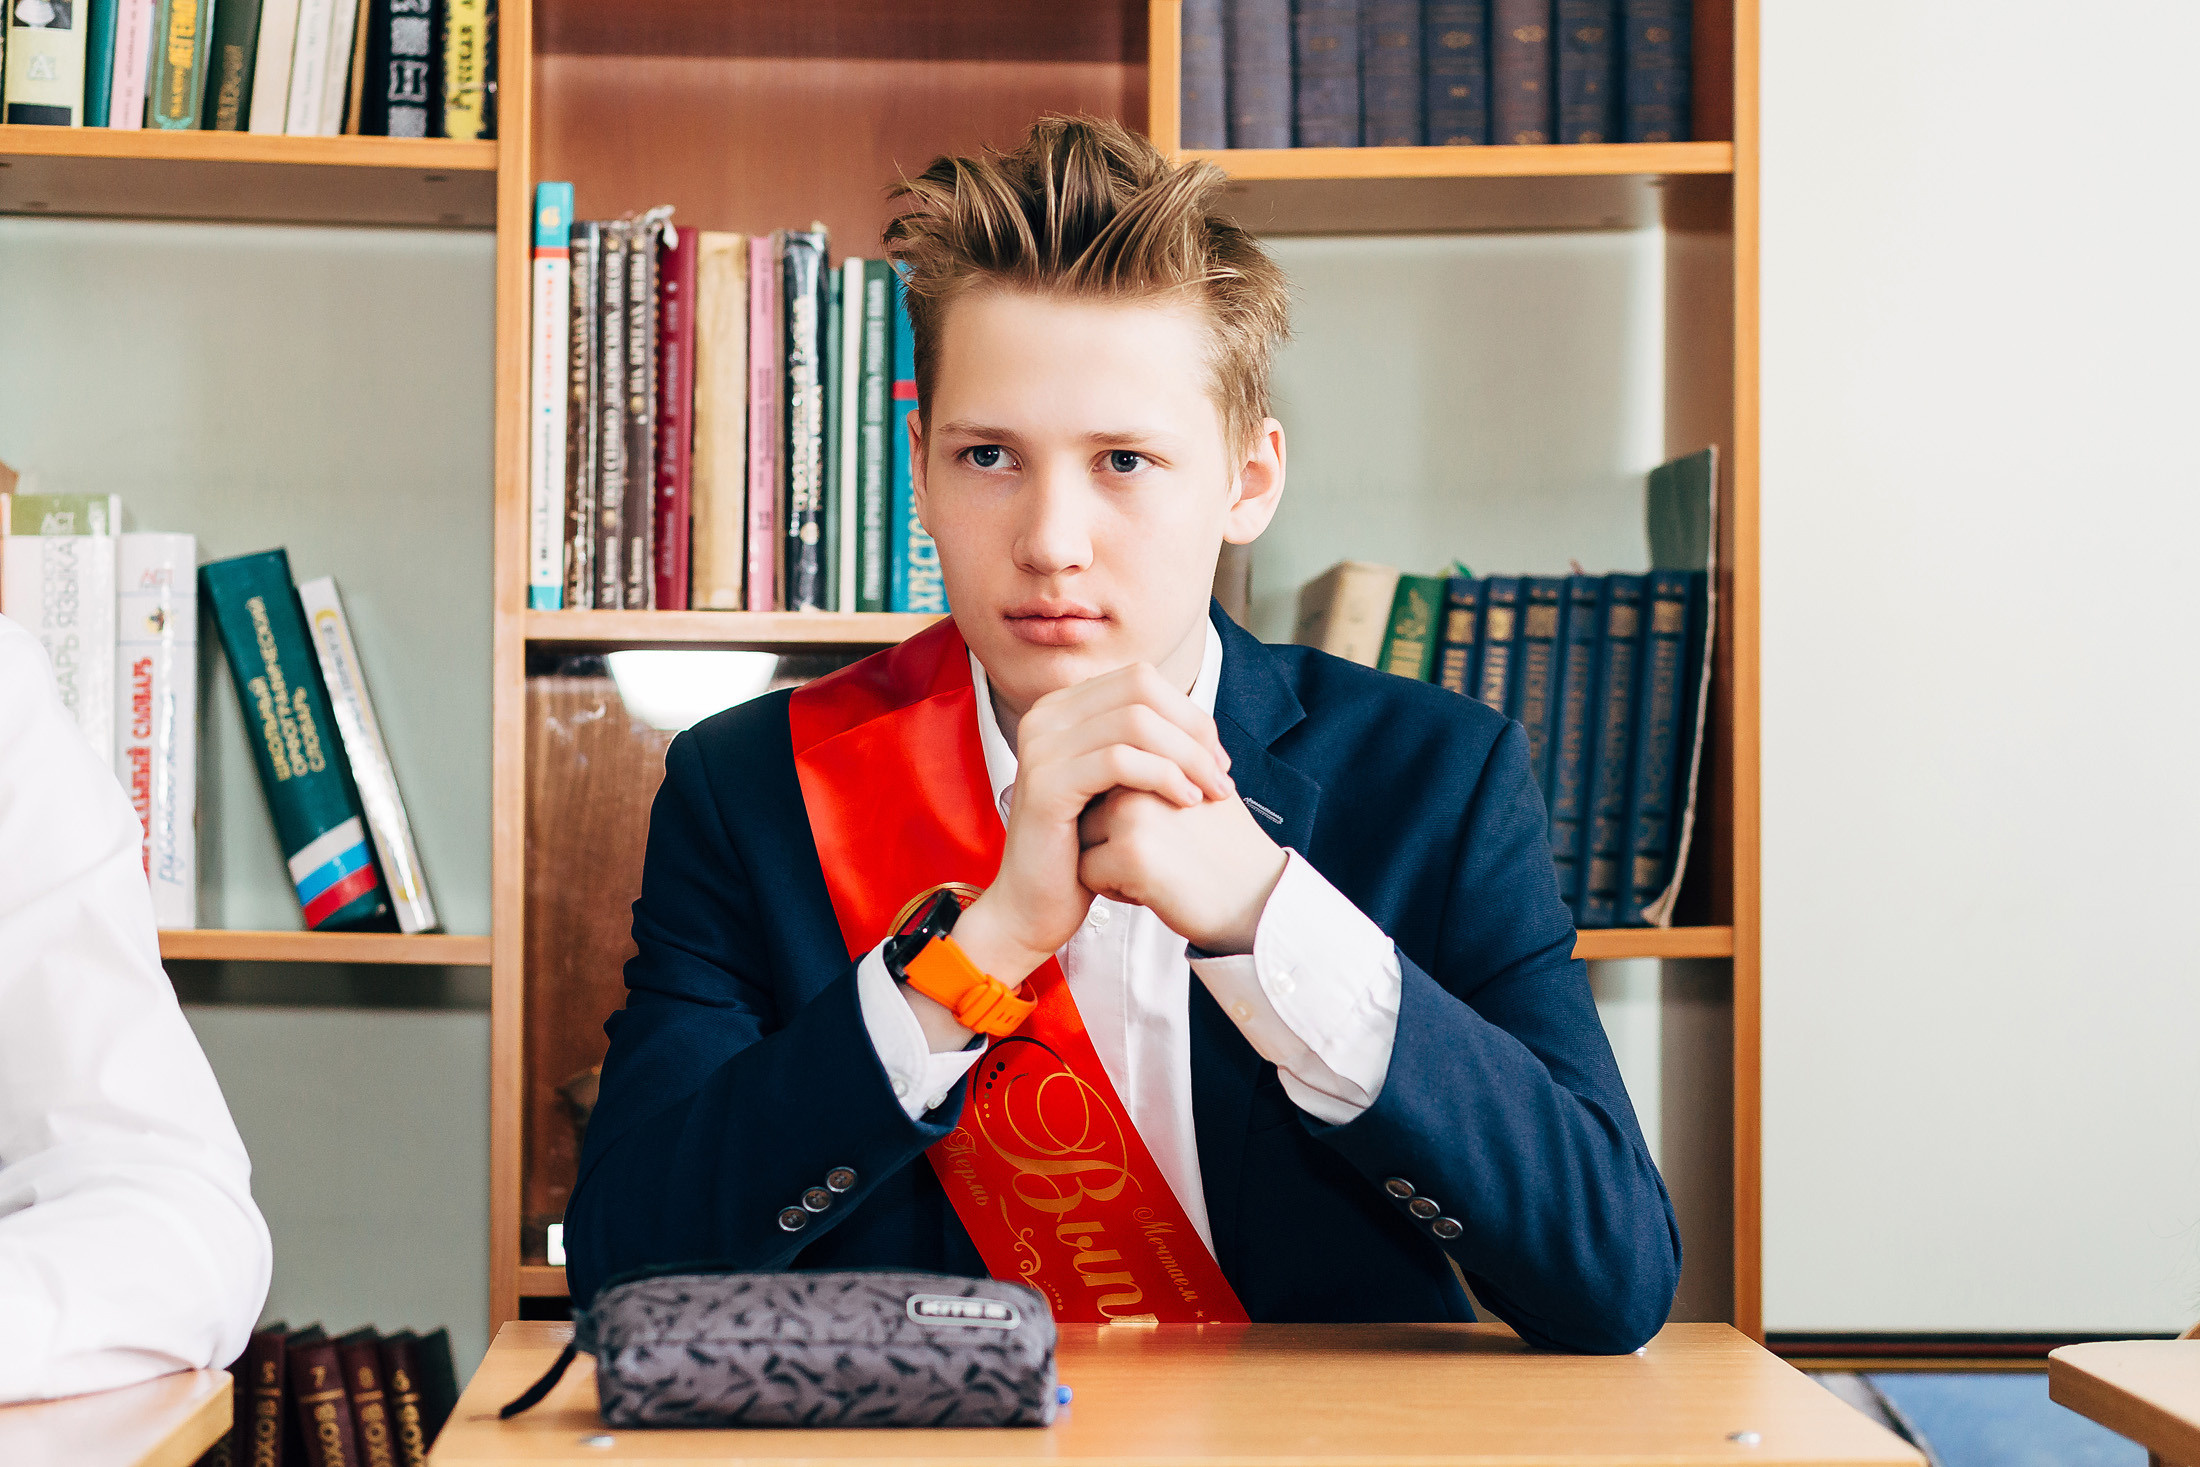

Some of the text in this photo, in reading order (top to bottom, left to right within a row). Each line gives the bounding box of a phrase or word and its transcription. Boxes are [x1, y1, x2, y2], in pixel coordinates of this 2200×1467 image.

[56, 537, 79, 628] ЯЗЫКА
[131, 657, 152, 739] СЛОВАРЬ
[246, 596, 309, 777] ОРФОГРАФИЧЕСКИЙ
[248, 676, 292, 781] ШКОЛЬНЫЙ
[293, 686, 327, 773] СЛОВАРЬ
[942, 1126, 988, 1207] Пермь
[1132, 1206, 1199, 1303] Мечтаем
[311, 1365, 327, 1389] 7
